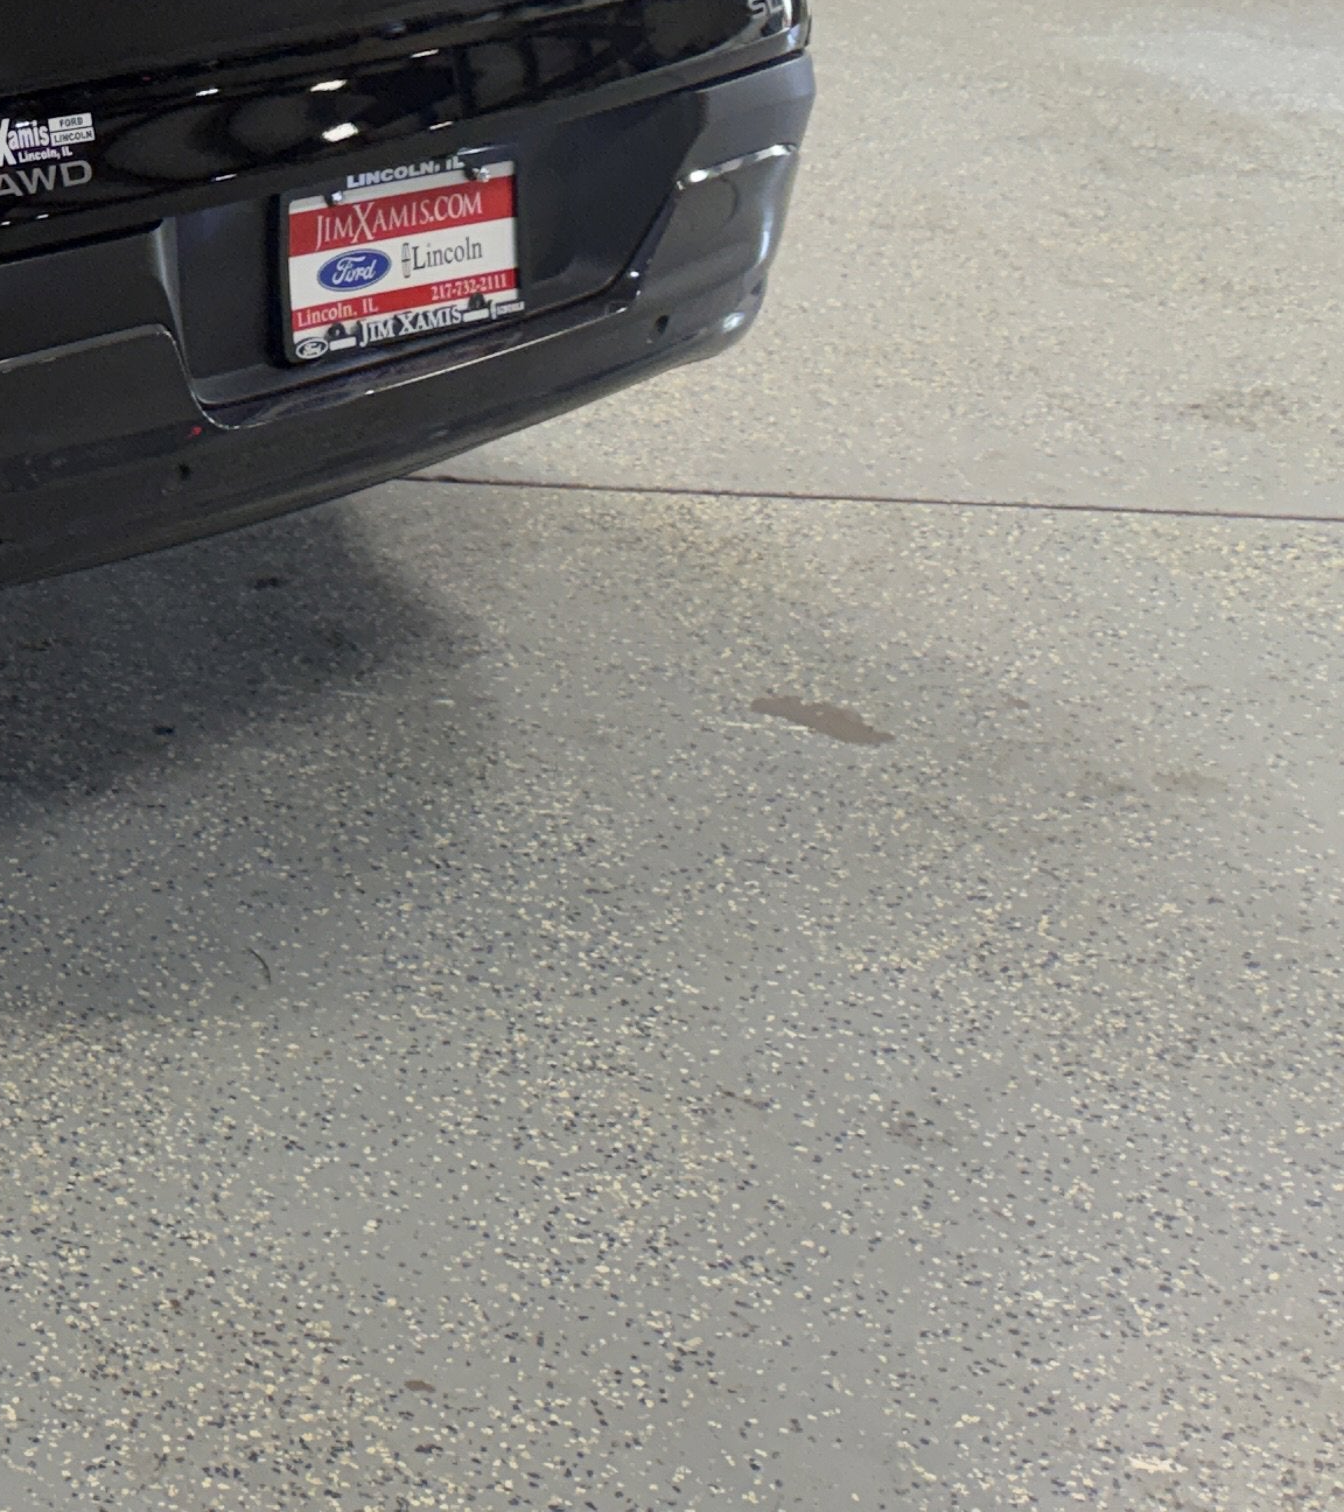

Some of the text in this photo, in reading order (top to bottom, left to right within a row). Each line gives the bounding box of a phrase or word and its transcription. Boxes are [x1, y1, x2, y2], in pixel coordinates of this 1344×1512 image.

[59, 116, 83, 128] FORD
[53, 130, 93, 144] LINCOLN
[18, 146, 72, 164] Lincoln, IL
[346, 160, 441, 188] LINCOLN,
[331, 236, 483, 285] Ford Lincoln
[362, 296, 379, 314] IL
